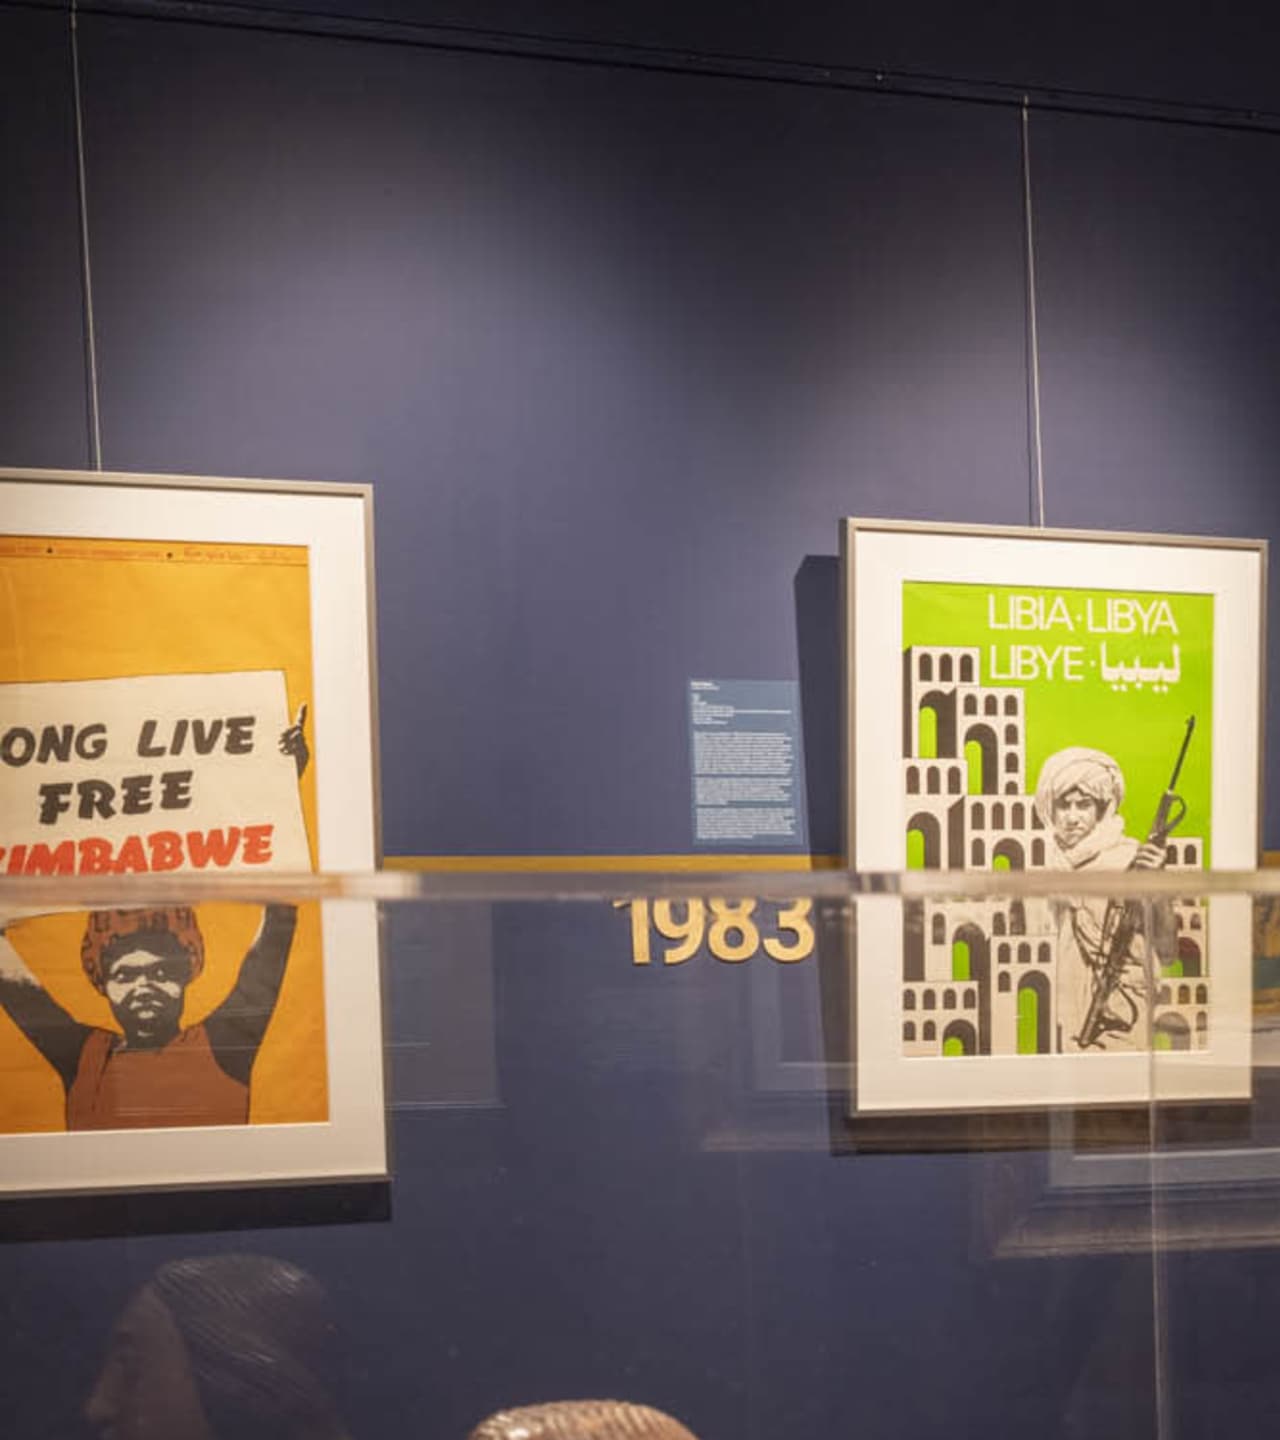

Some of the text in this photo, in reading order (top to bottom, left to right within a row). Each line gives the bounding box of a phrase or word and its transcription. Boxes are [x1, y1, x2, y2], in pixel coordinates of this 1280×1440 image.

[988, 594, 1179, 635] LIBIA LIBYA
[990, 644, 1084, 681] LIBYE
[1101, 641, 1180, 692] ليبيا
[0, 716, 256, 767] ONG LIVE
[39, 770, 193, 825] FREE
[0, 824, 274, 876] IMBABWE
[613, 897, 815, 965] 1983
